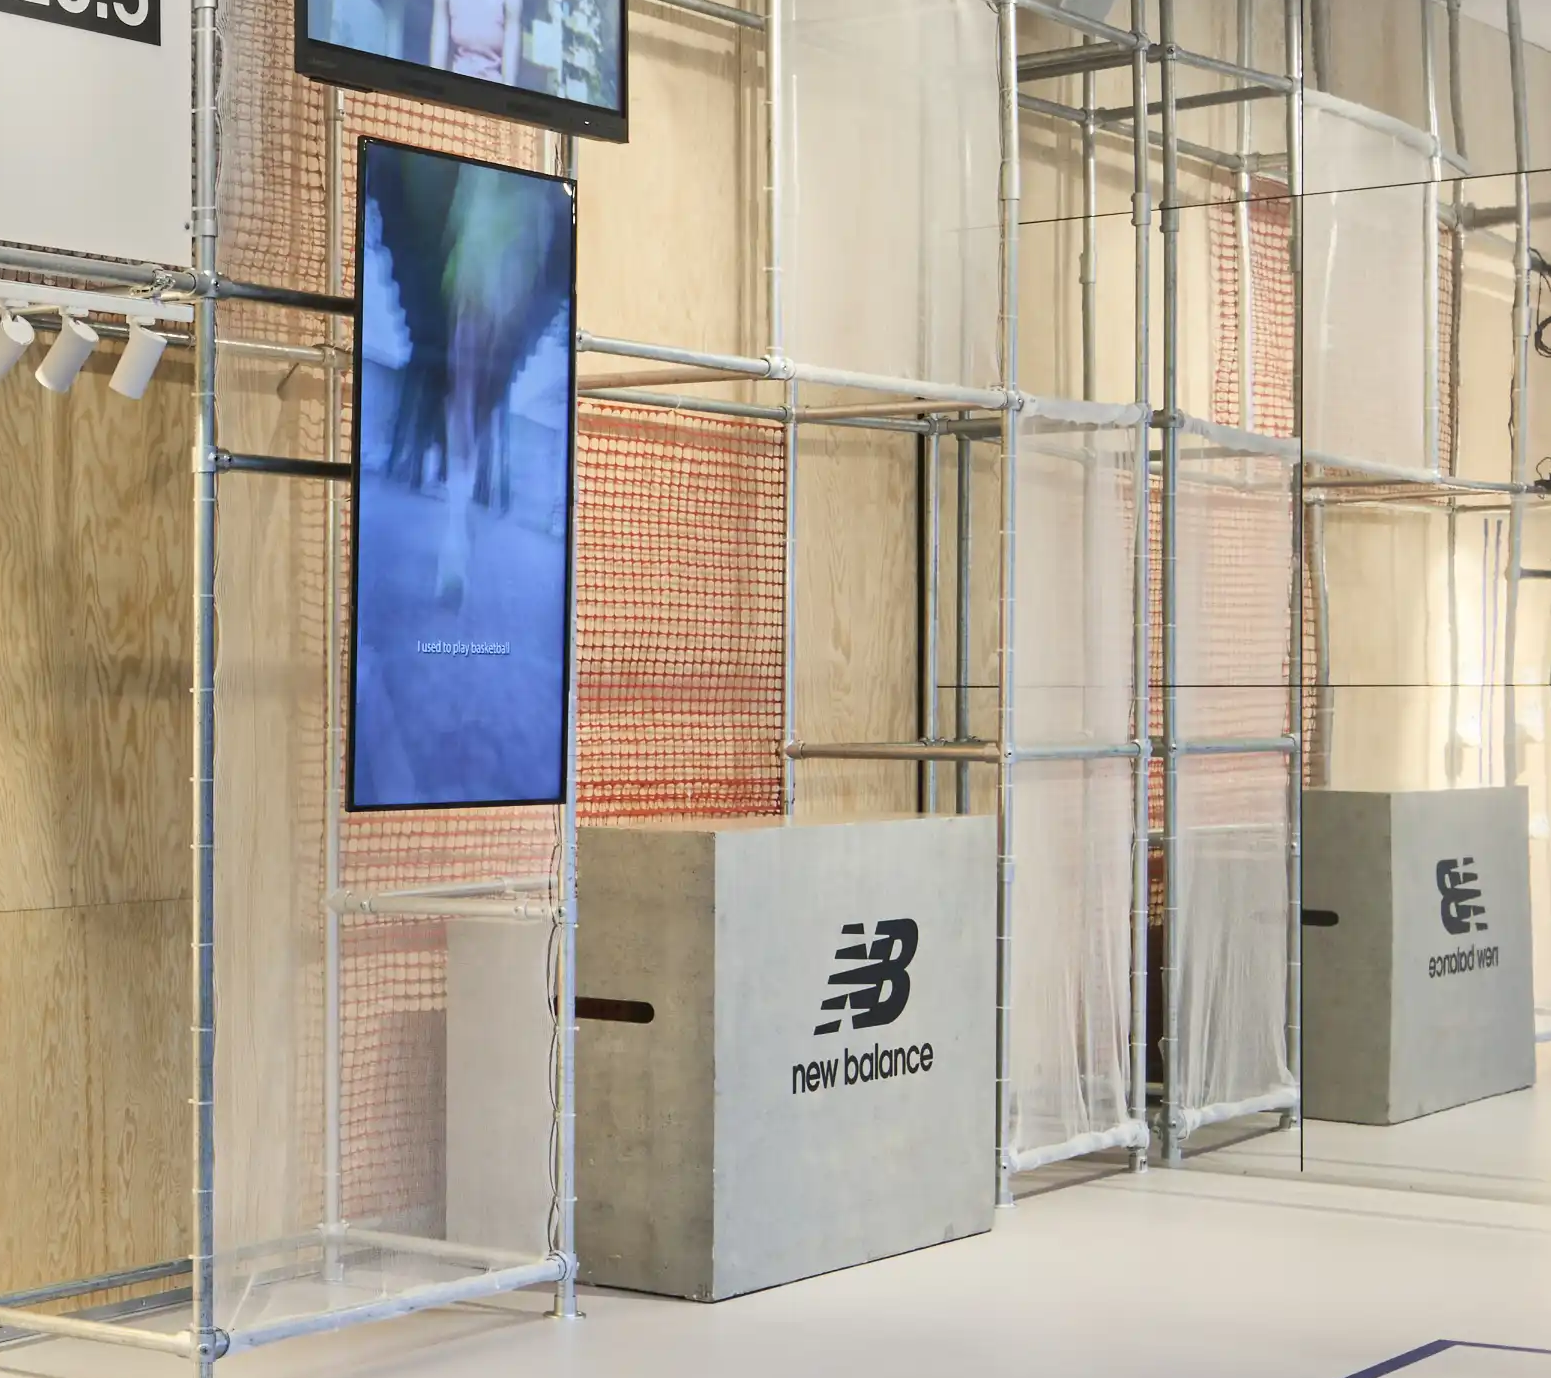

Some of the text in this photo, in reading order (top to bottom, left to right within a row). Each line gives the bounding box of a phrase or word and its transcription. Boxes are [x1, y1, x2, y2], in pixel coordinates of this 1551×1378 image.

[422, 640, 441, 653] used
[444, 642, 452, 653] to
[453, 641, 469, 656] play
[471, 642, 510, 654] basketball
[792, 1042, 934, 1095] new balance
